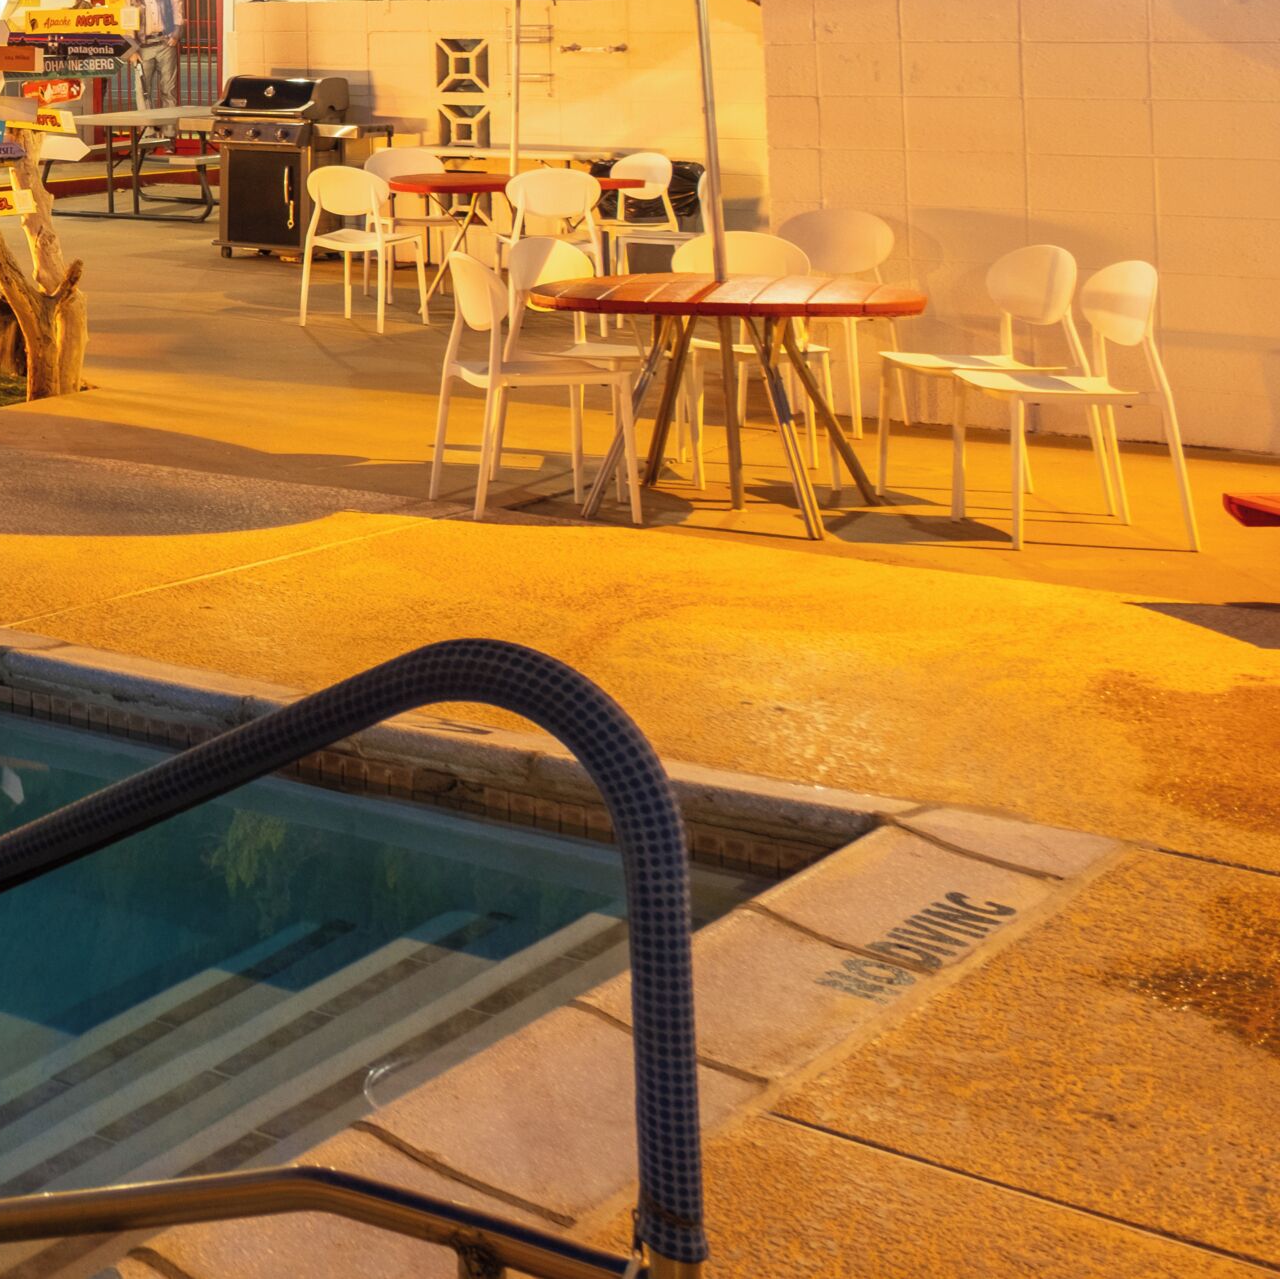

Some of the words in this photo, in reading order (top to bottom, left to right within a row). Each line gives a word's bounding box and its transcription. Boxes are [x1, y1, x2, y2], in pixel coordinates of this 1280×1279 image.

[43, 17, 72, 29] Apache
[75, 14, 119, 28] MOTEL
[67, 45, 115, 55] patagonia
[44, 57, 115, 72] OHANESBERG
[864, 891, 1017, 970] DIVING
